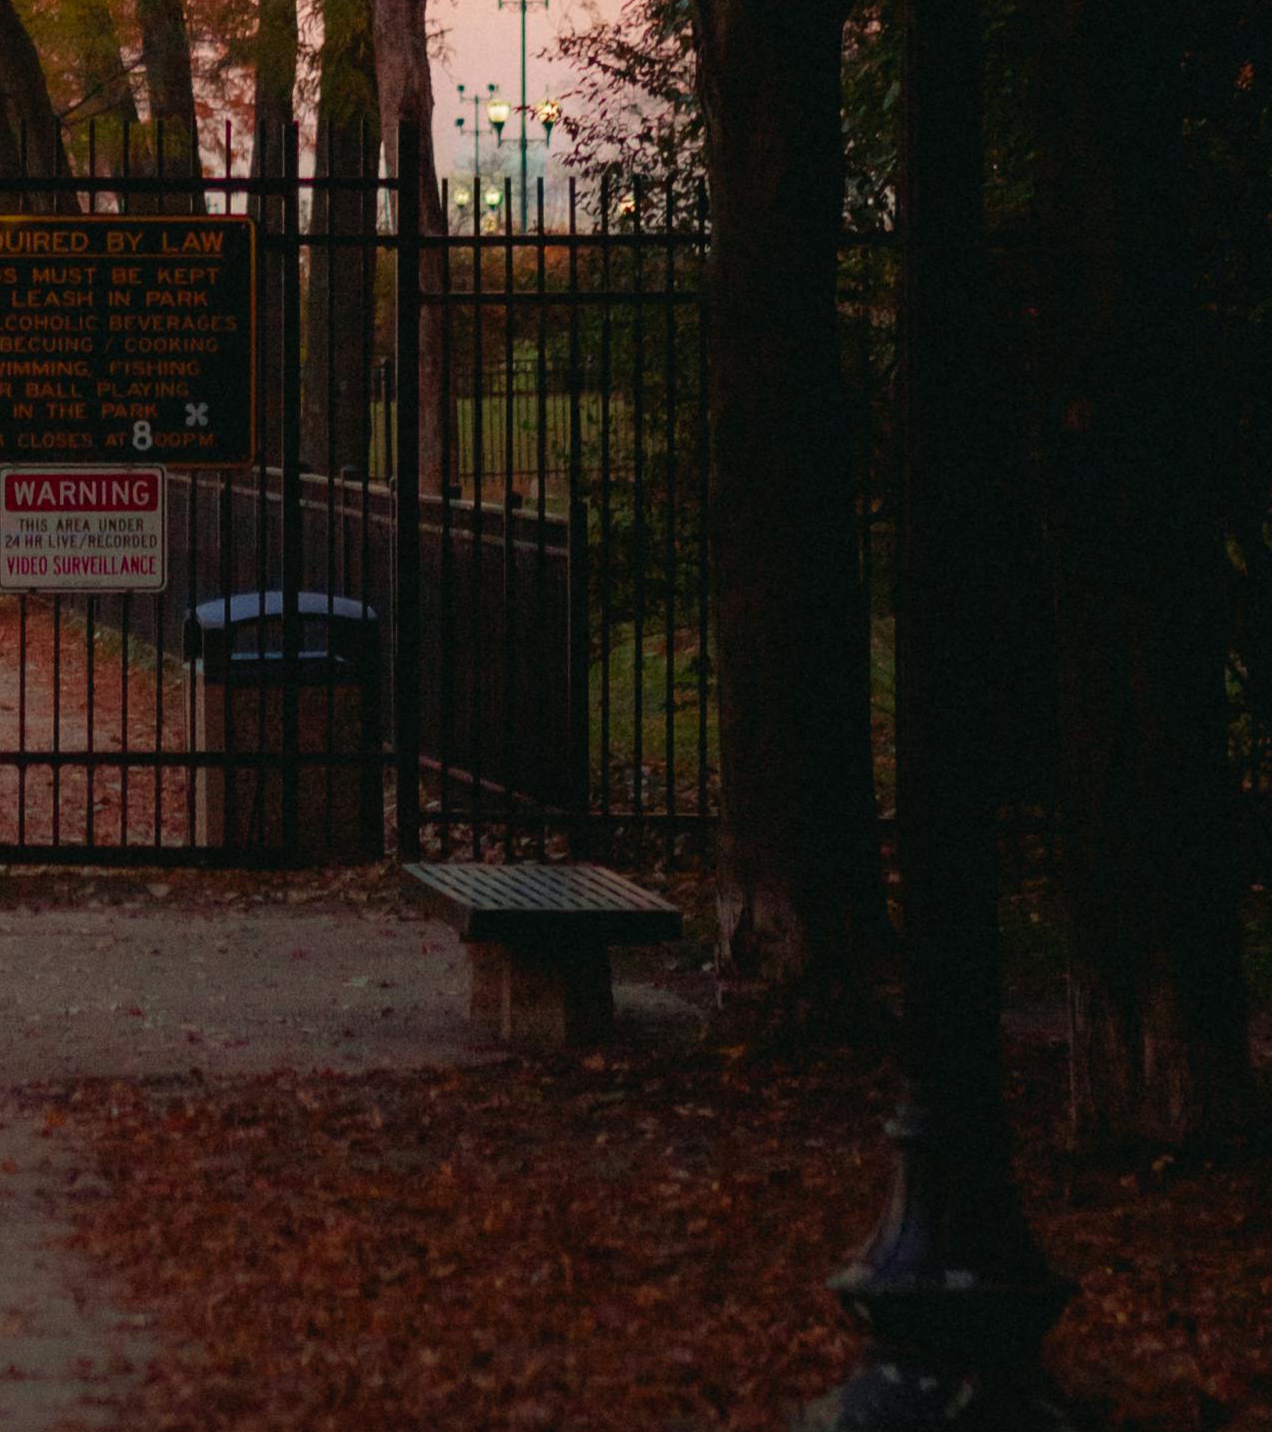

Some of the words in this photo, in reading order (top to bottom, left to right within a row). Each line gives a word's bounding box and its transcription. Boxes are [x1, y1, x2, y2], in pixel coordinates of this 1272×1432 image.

[107, 230, 144, 254] BY
[161, 230, 225, 254] LAW
[31, 266, 97, 285] MUST
[111, 266, 144, 285] BE
[157, 266, 220, 285] KEPT
[11, 289, 94, 307] LEASH
[107, 289, 132, 307] IN
[145, 289, 208, 307] PARK
[108, 313, 239, 332] BEVERAGES
[125, 337, 220, 354] COOKING
[110, 360, 202, 378] FISHING
[26, 381, 83, 399] BALL
[95, 381, 191, 399] PLAYING
[12, 401, 34, 419] IN
[47, 401, 88, 418] THE
[100, 401, 158, 419] PARK
[18, 433, 94, 450] CLOSES
[105, 432, 127, 448] AT
[12, 480, 151, 507] WARNING
[19, 518, 48, 533] THIS
[56, 518, 91, 533] AREA
[98, 518, 145, 533] UNDER
[5, 534, 20, 549] 24
[25, 534, 43, 549] HR
[48, 534, 158, 549] LIVE/RECORDED
[7, 556, 48, 576] VIDEO
[53, 556, 157, 576] SURVEILLANCE
